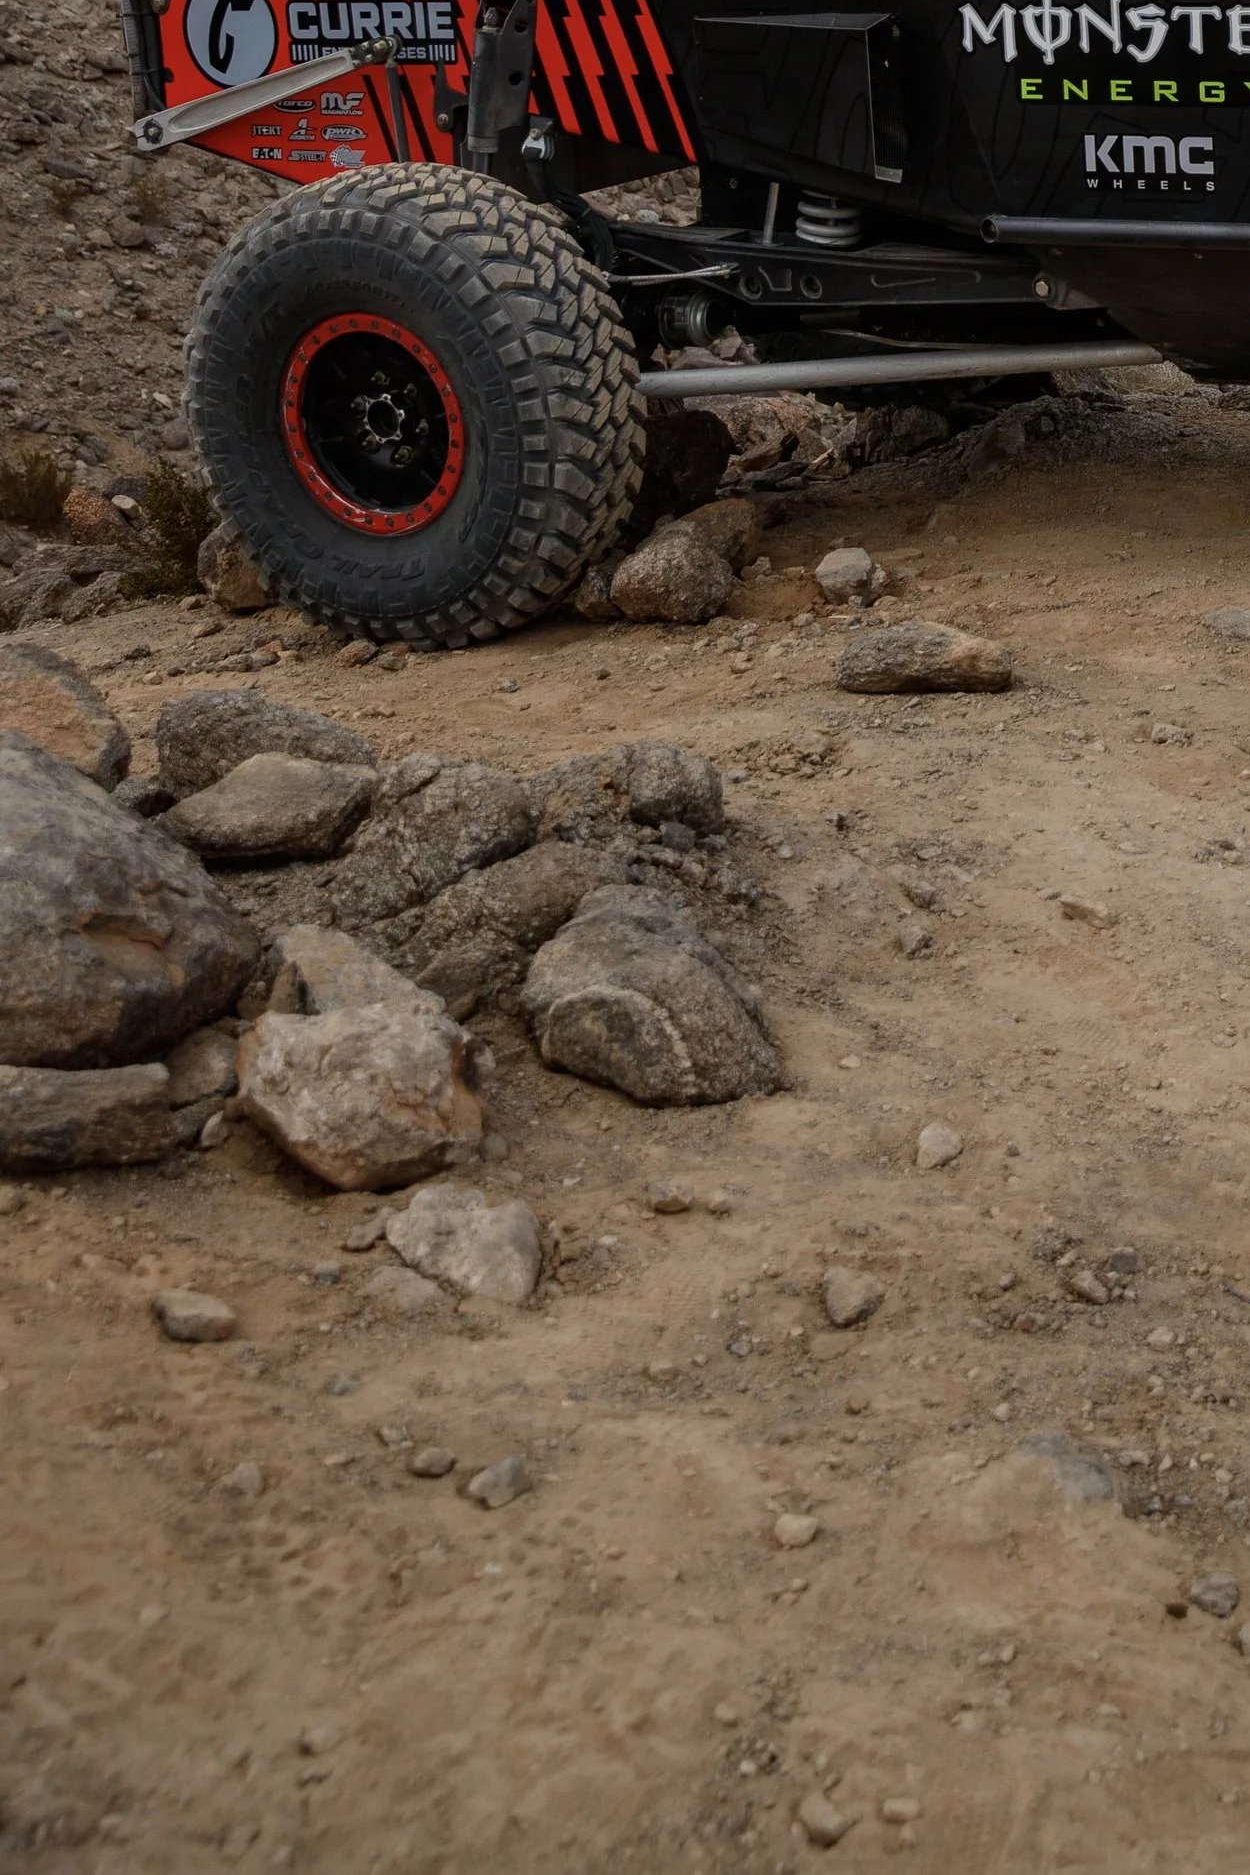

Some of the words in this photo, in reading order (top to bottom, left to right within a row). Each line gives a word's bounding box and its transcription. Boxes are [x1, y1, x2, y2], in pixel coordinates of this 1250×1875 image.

[288, 2, 455, 39] CURRIE
[253, 126, 282, 136] JTEKT
[253, 148, 282, 159] EATON
[1087, 178, 1215, 191] WHEELS
